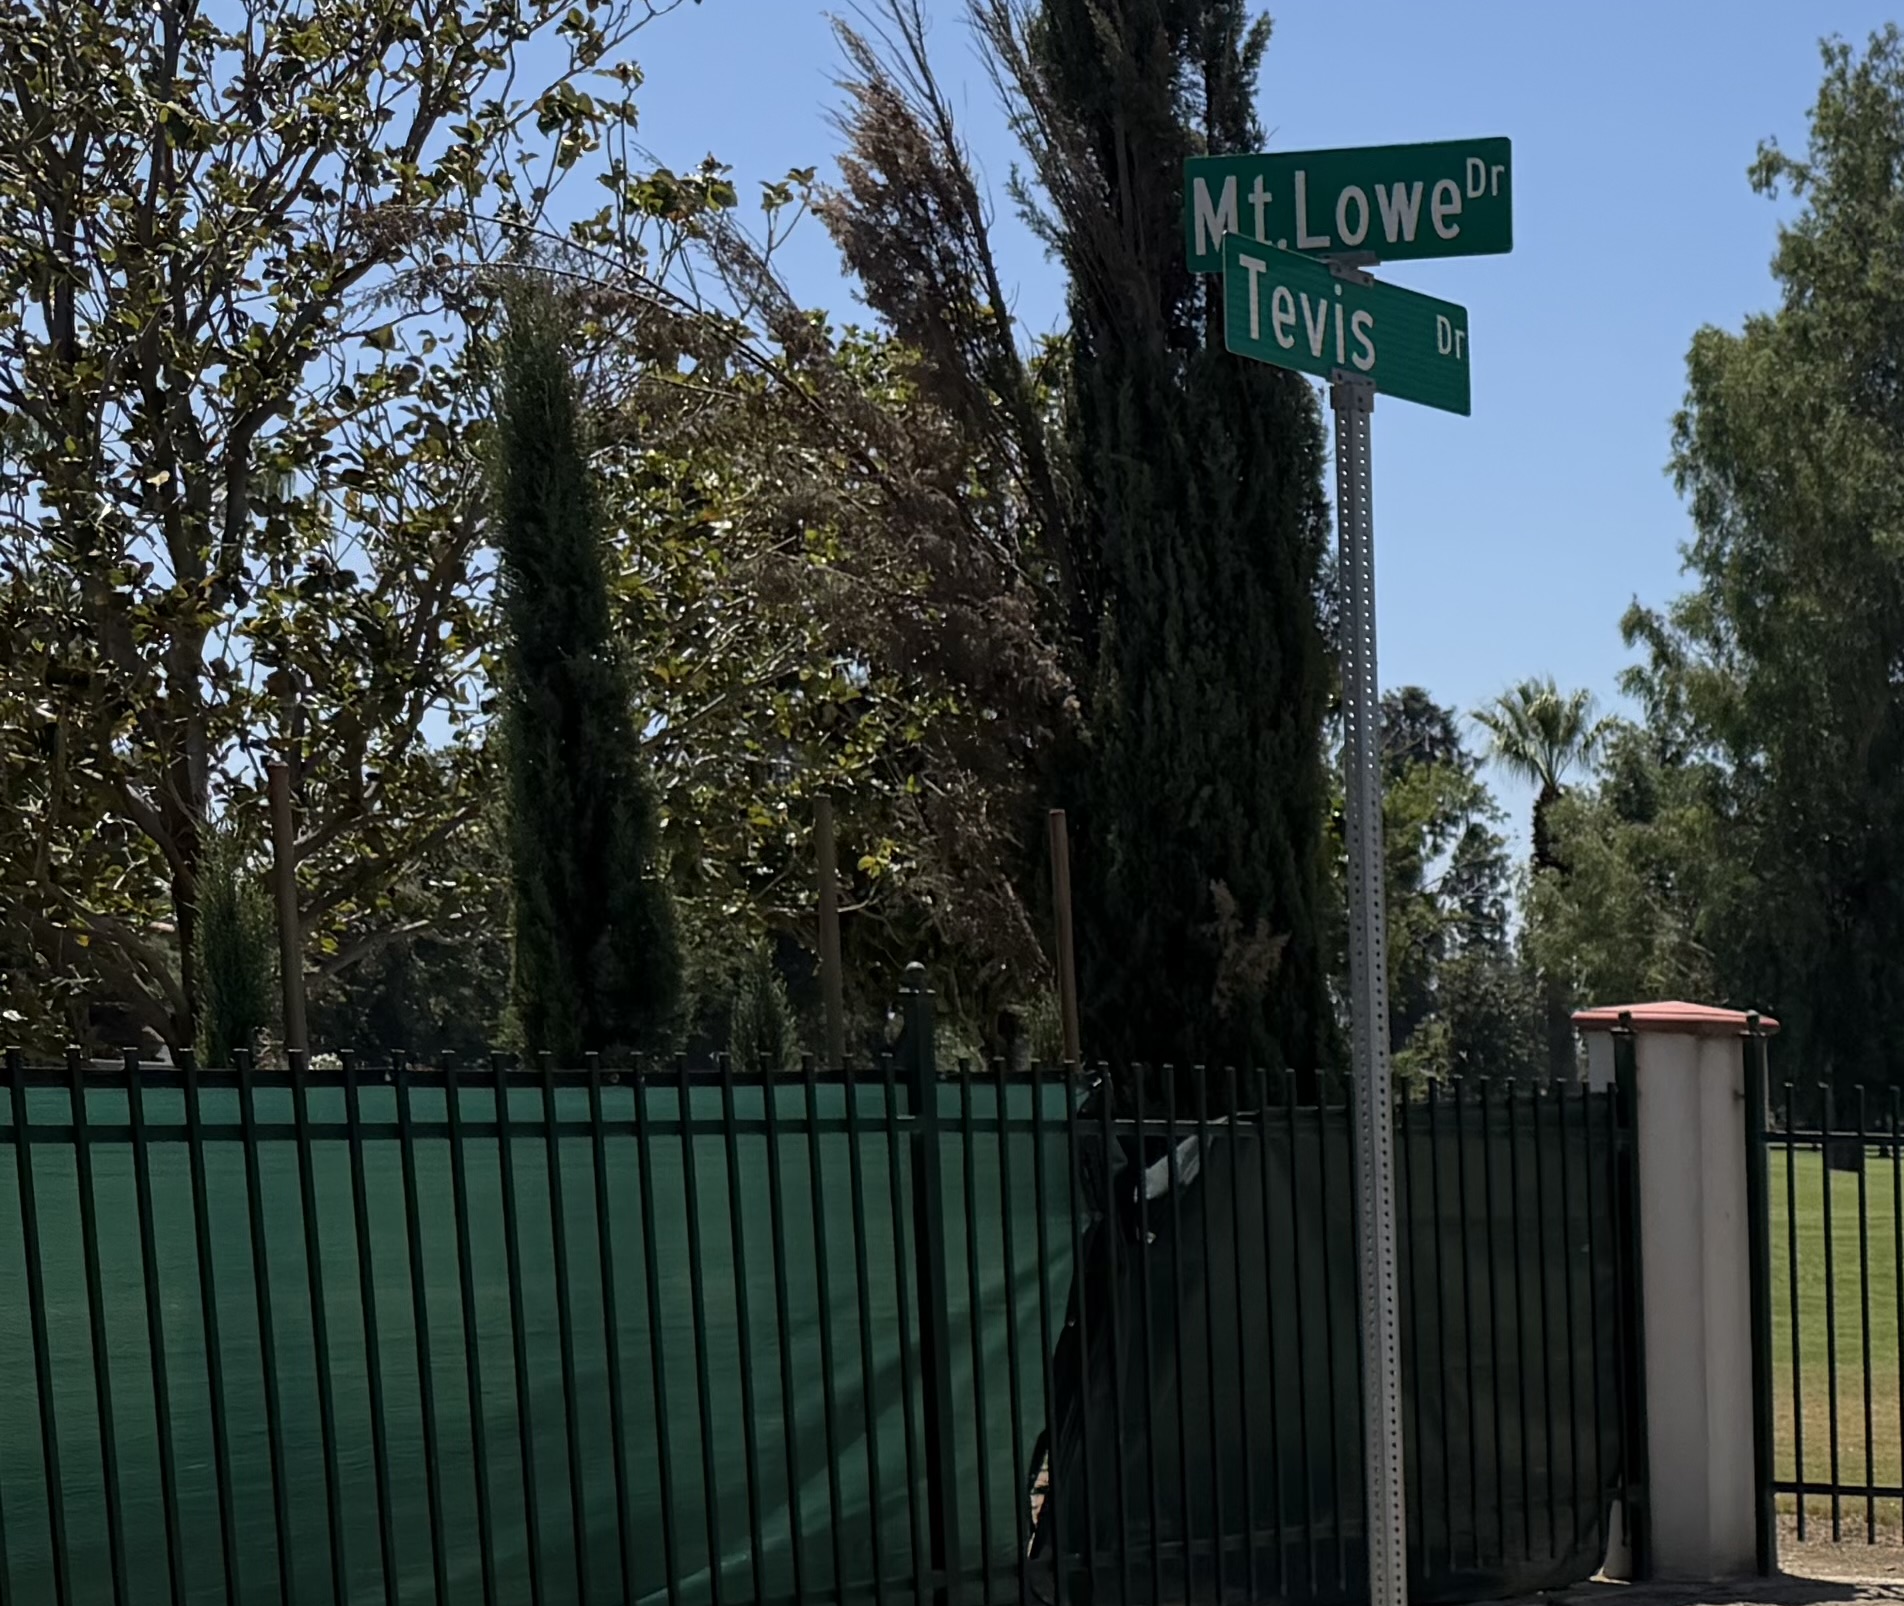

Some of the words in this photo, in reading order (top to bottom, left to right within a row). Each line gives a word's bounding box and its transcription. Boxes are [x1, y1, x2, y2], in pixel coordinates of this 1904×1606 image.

[1466, 157, 1505, 199] Dr
[1238, 253, 1376, 372] Tevis
[1436, 314, 1465, 360] Dr
